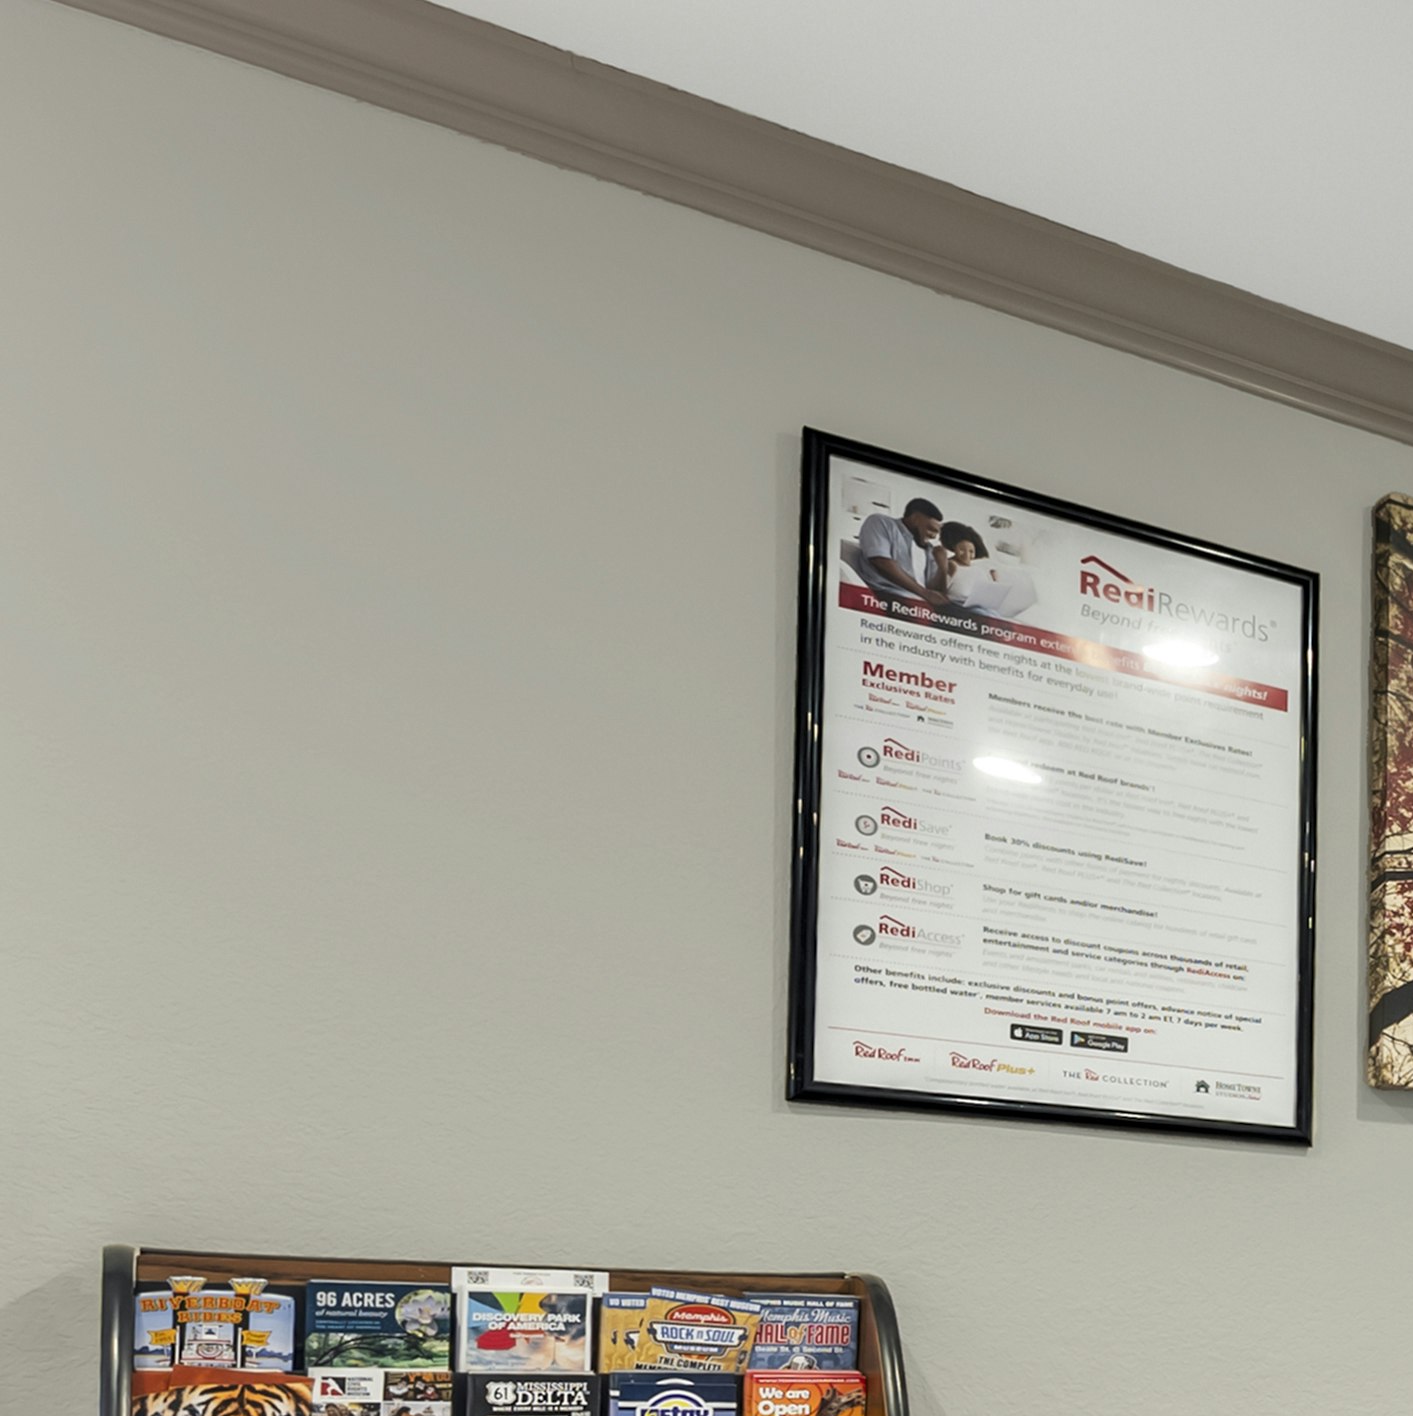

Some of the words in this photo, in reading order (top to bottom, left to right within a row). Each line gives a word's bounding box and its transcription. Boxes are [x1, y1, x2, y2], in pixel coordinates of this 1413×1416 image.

[861, 594, 887, 611] The
[892, 601, 978, 632] RediRewards
[981, 624, 1036, 645] program
[860, 619, 937, 644] RediRewards
[940, 637, 974, 653] offers
[977, 644, 1000, 659] free
[1004, 651, 1037, 670] nights
[1040, 660, 1051, 670] at
[1055, 663, 1072, 676] the
[876, 637, 895, 650] the
[899, 642, 947, 664] industry
[949, 652, 975, 667] with
[979, 658, 1024, 679] benefits
[1028, 668, 1043, 682] for
[1047, 676, 1094, 697] everyday
[863, 661, 957, 694] Member
[862, 678, 921, 698] Exclusives
[924, 690, 956, 705] Rates
[854, 965, 882, 975] Other
[885, 969, 925, 980] benefits
[1063, 1070, 1081, 1079] THE
[1102, 1075, 1168, 1089] COLLECTION
[140, 1295, 281, 1313] RIVERBOAT
[316, 1291, 337, 1307] 96
[341, 1292, 395, 1307] ACRES
[177, 1312, 242, 1323] RIDES
[472, 1313, 545, 1323] DISCOVERY
[548, 1313, 581, 1323] PARK
[673, 1310, 727, 1324] Memphis
[488, 1322, 506, 1331] OF
[507, 1321, 566, 1331] AMERICA
[661, 1326, 694, 1341] ROCK
[705, 1329, 737, 1343] SOUL
[494, 1387, 508, 1401] 61
[517, 1382, 588, 1392] MISSISSIPPI
[759, 1388, 782, 1400] We
[785, 1390, 810, 1399] are
[516, 1391, 588, 1405] DELTA
[758, 1402, 810, 1416] Open
